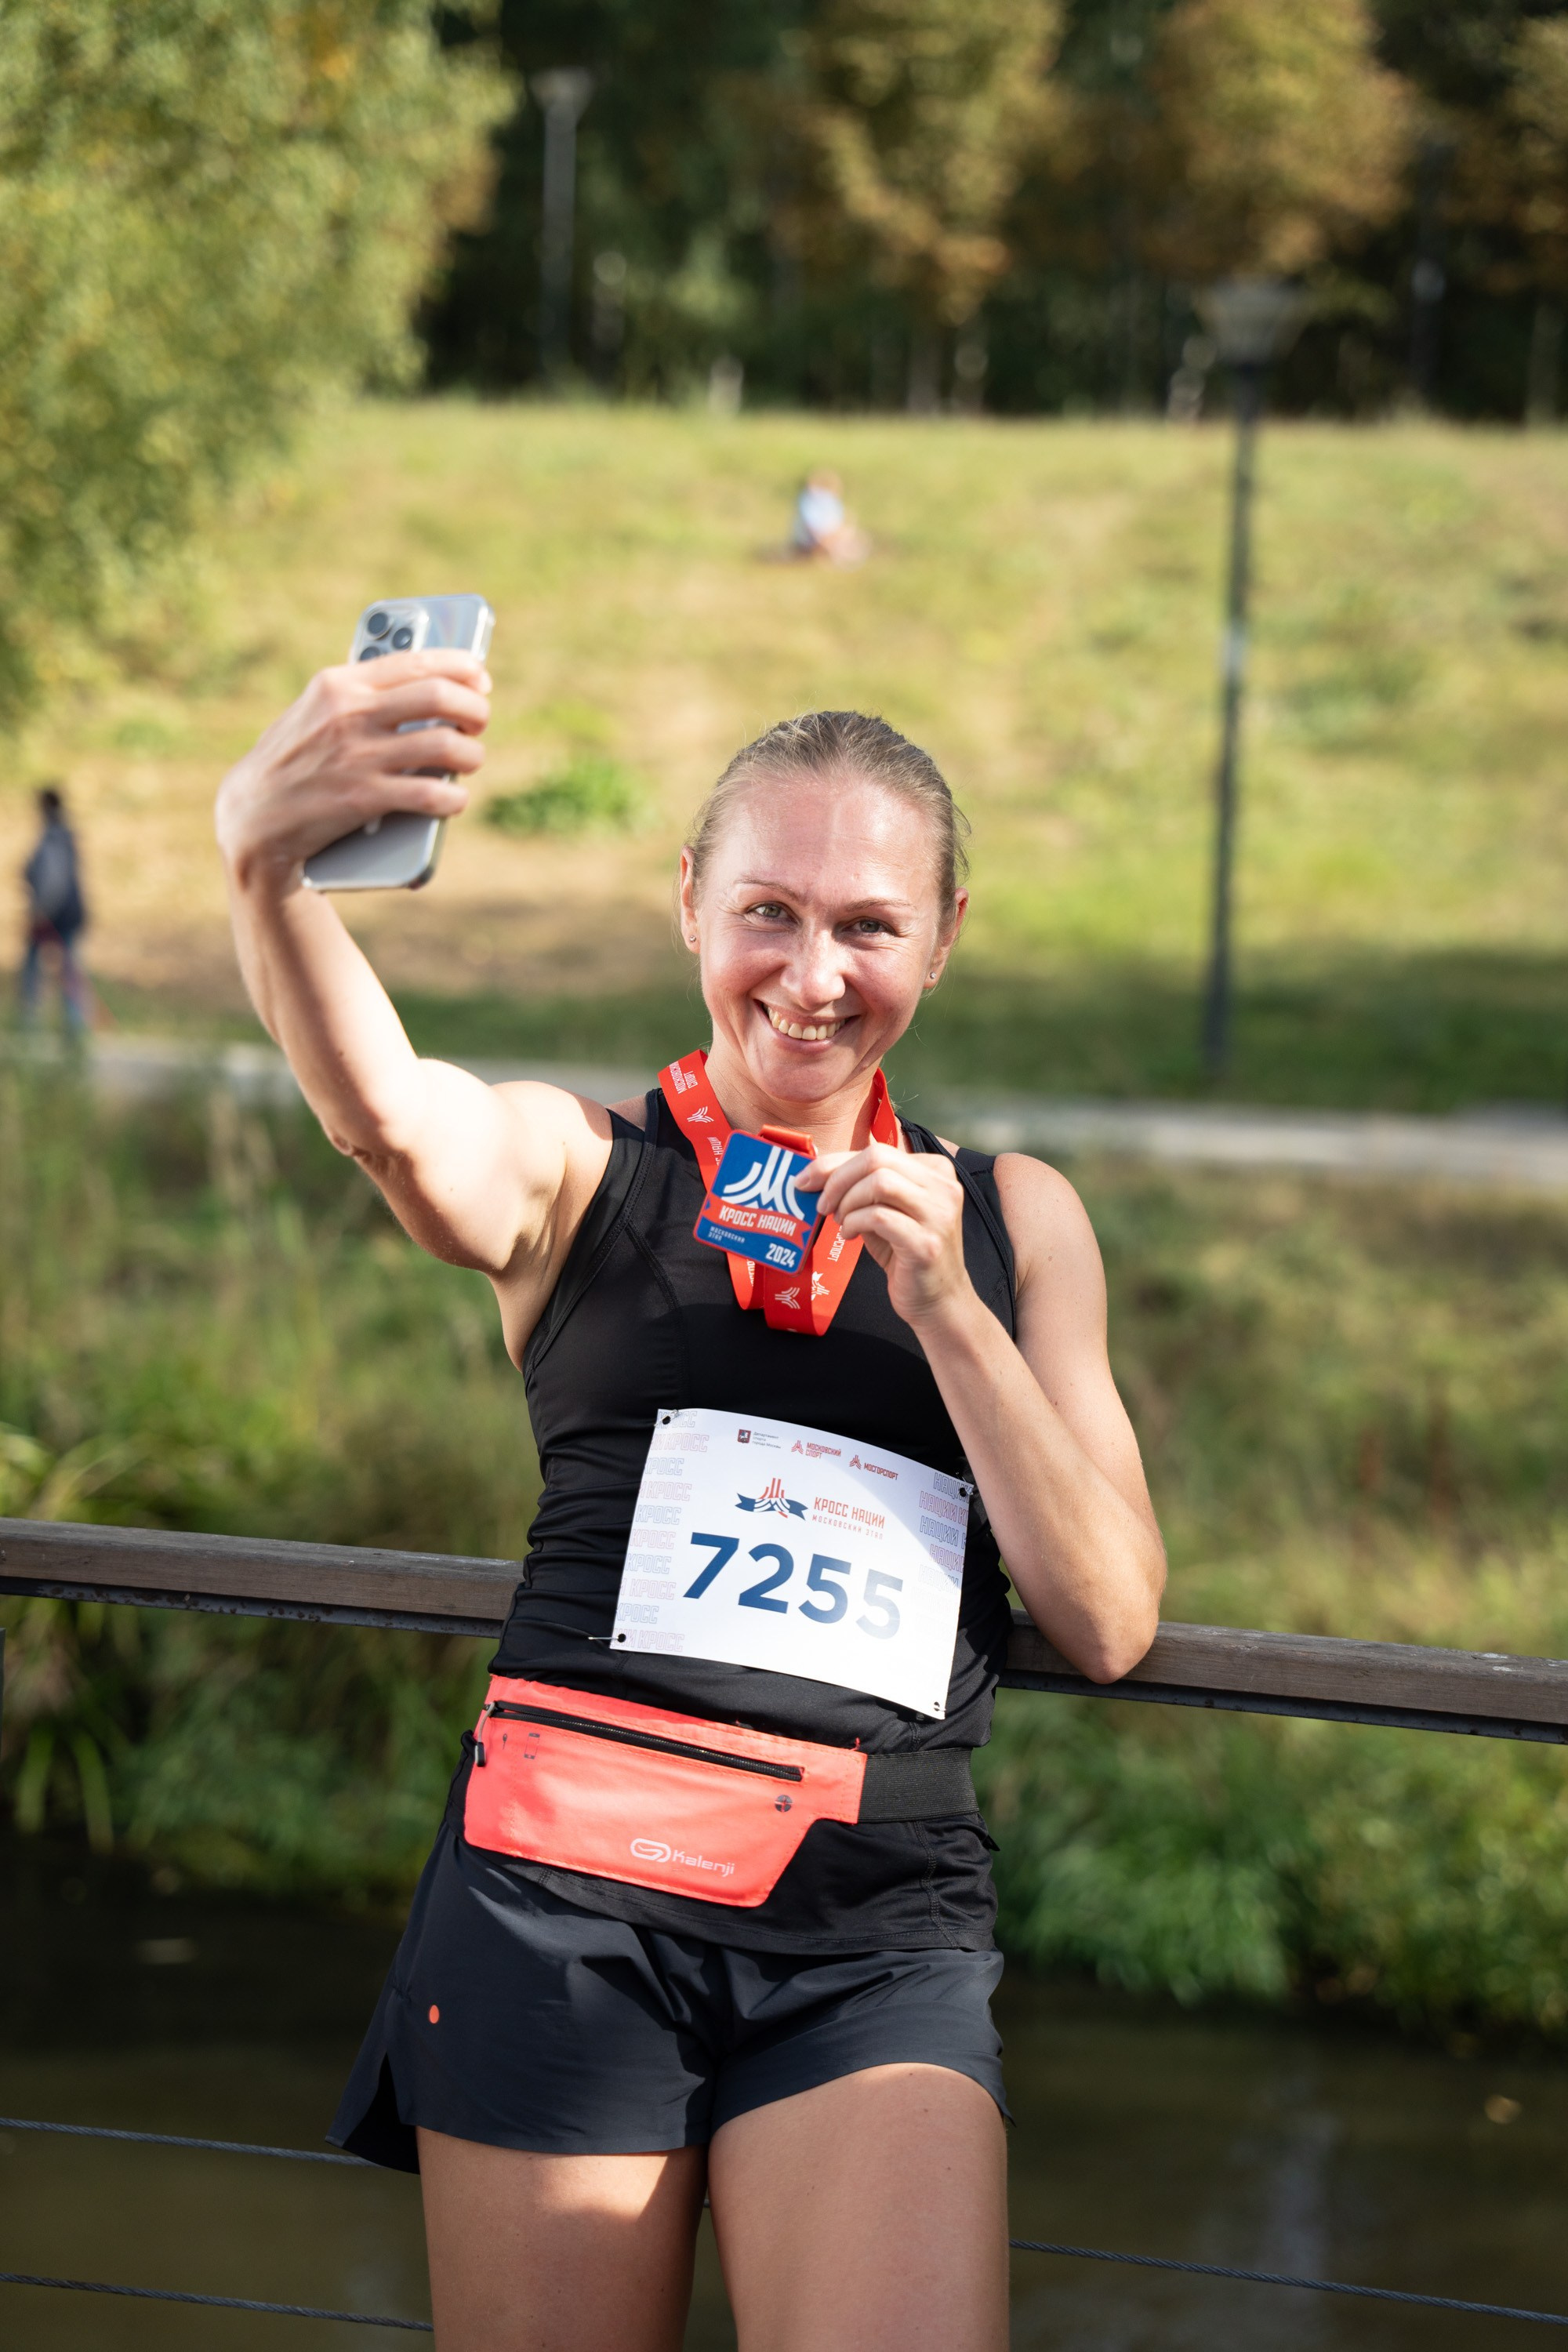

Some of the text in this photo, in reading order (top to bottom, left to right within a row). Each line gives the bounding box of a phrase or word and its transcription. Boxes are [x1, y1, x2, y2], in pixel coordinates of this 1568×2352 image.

[669, 1061, 688, 1094] МОСКОВСКИ
[683, 1070, 699, 1089] СПОРТ
[719, 1205, 797, 1237] КРОСС НАЦИИ
[710, 1225, 746, 1243] МОСКОВСКИЙ
[765, 1243, 797, 1269] 2024
[656, 1410, 698, 1429] КОСС
[663, 1432, 710, 1453] КРОСС
[805, 1449, 823, 1459] СПОРТ
[806, 1442, 841, 1457] МОСКОВСКИЙ
[863, 1462, 899, 1481] МОСГОРСПОРТ
[646, 1481, 692, 1501] КРОСС
[635, 1504, 682, 1526] КРОСС
[814, 1497, 885, 1530] КРОСС НАЦИИ
[918, 1490, 958, 1523] НАЦИИ
[630, 1528, 677, 1550] КРОСС
[811, 1514, 884, 1541] МОСКОВСКИЙ ЭТАП
[919, 1515, 959, 1547] НАЦИИ
[625, 1552, 672, 1575] КРОСС
[630, 1578, 677, 1601] КРОСС
[683, 1532, 903, 1640] 7255
[637, 1629, 685, 1653] КРОСС
[672, 1849, 735, 1878] Kalenji
